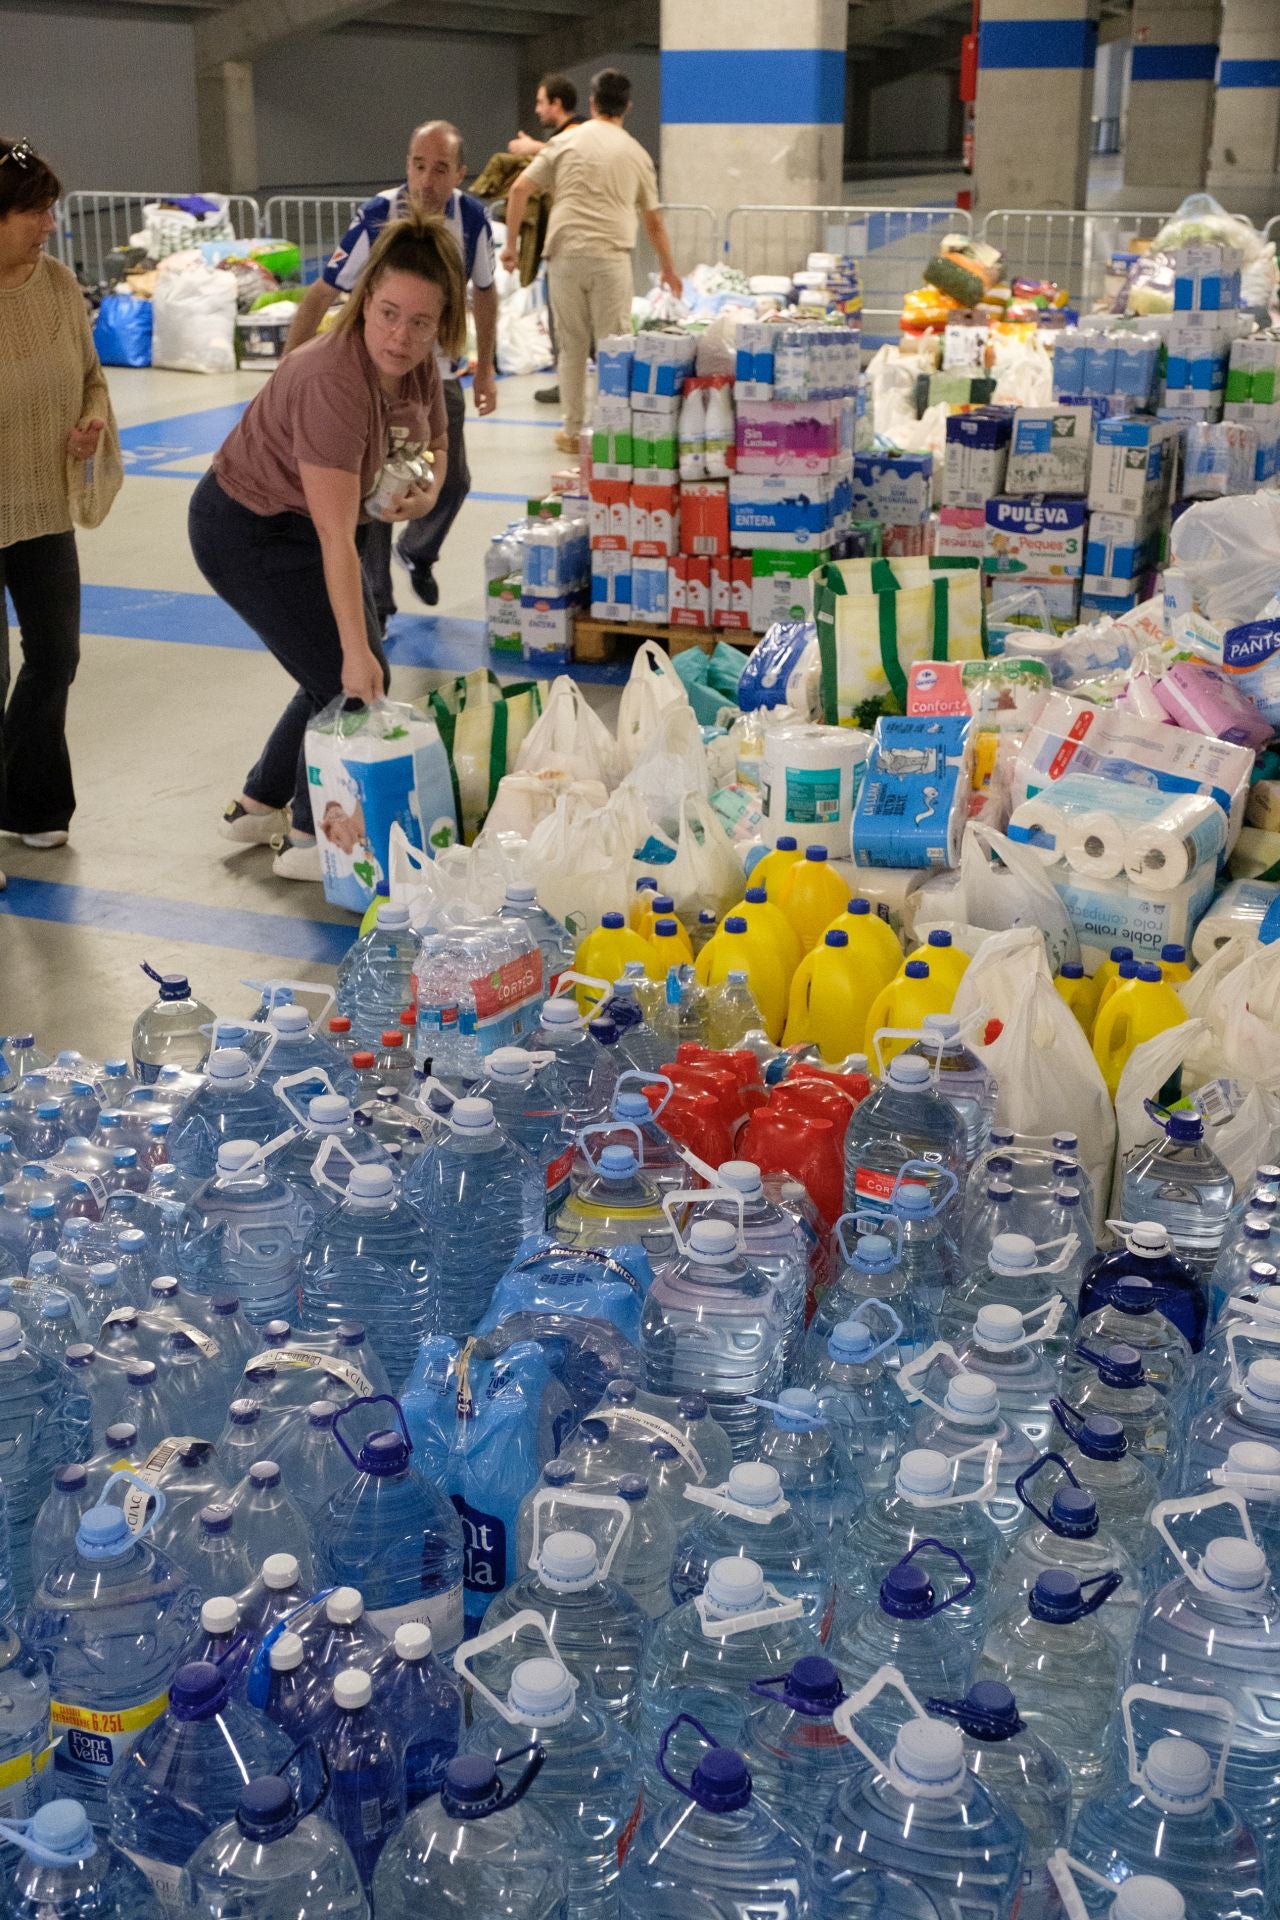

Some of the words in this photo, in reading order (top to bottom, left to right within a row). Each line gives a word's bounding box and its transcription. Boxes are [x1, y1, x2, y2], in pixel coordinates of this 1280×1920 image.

[735, 515, 776, 527] ENTERA
[998, 504, 1069, 524] PULEVA
[1020, 537, 1063, 552] Peques
[1065, 538, 1079, 555] 3
[1230, 630, 1280, 658] PANTS
[912, 701, 960, 713] Confort
[1084, 921, 1118, 937] rollo
[1122, 928, 1163, 947] doble
[91, 1713, 125, 1733] 6.25L
[72, 1731, 108, 1752] Font
[72, 1744, 110, 1764] Vella
